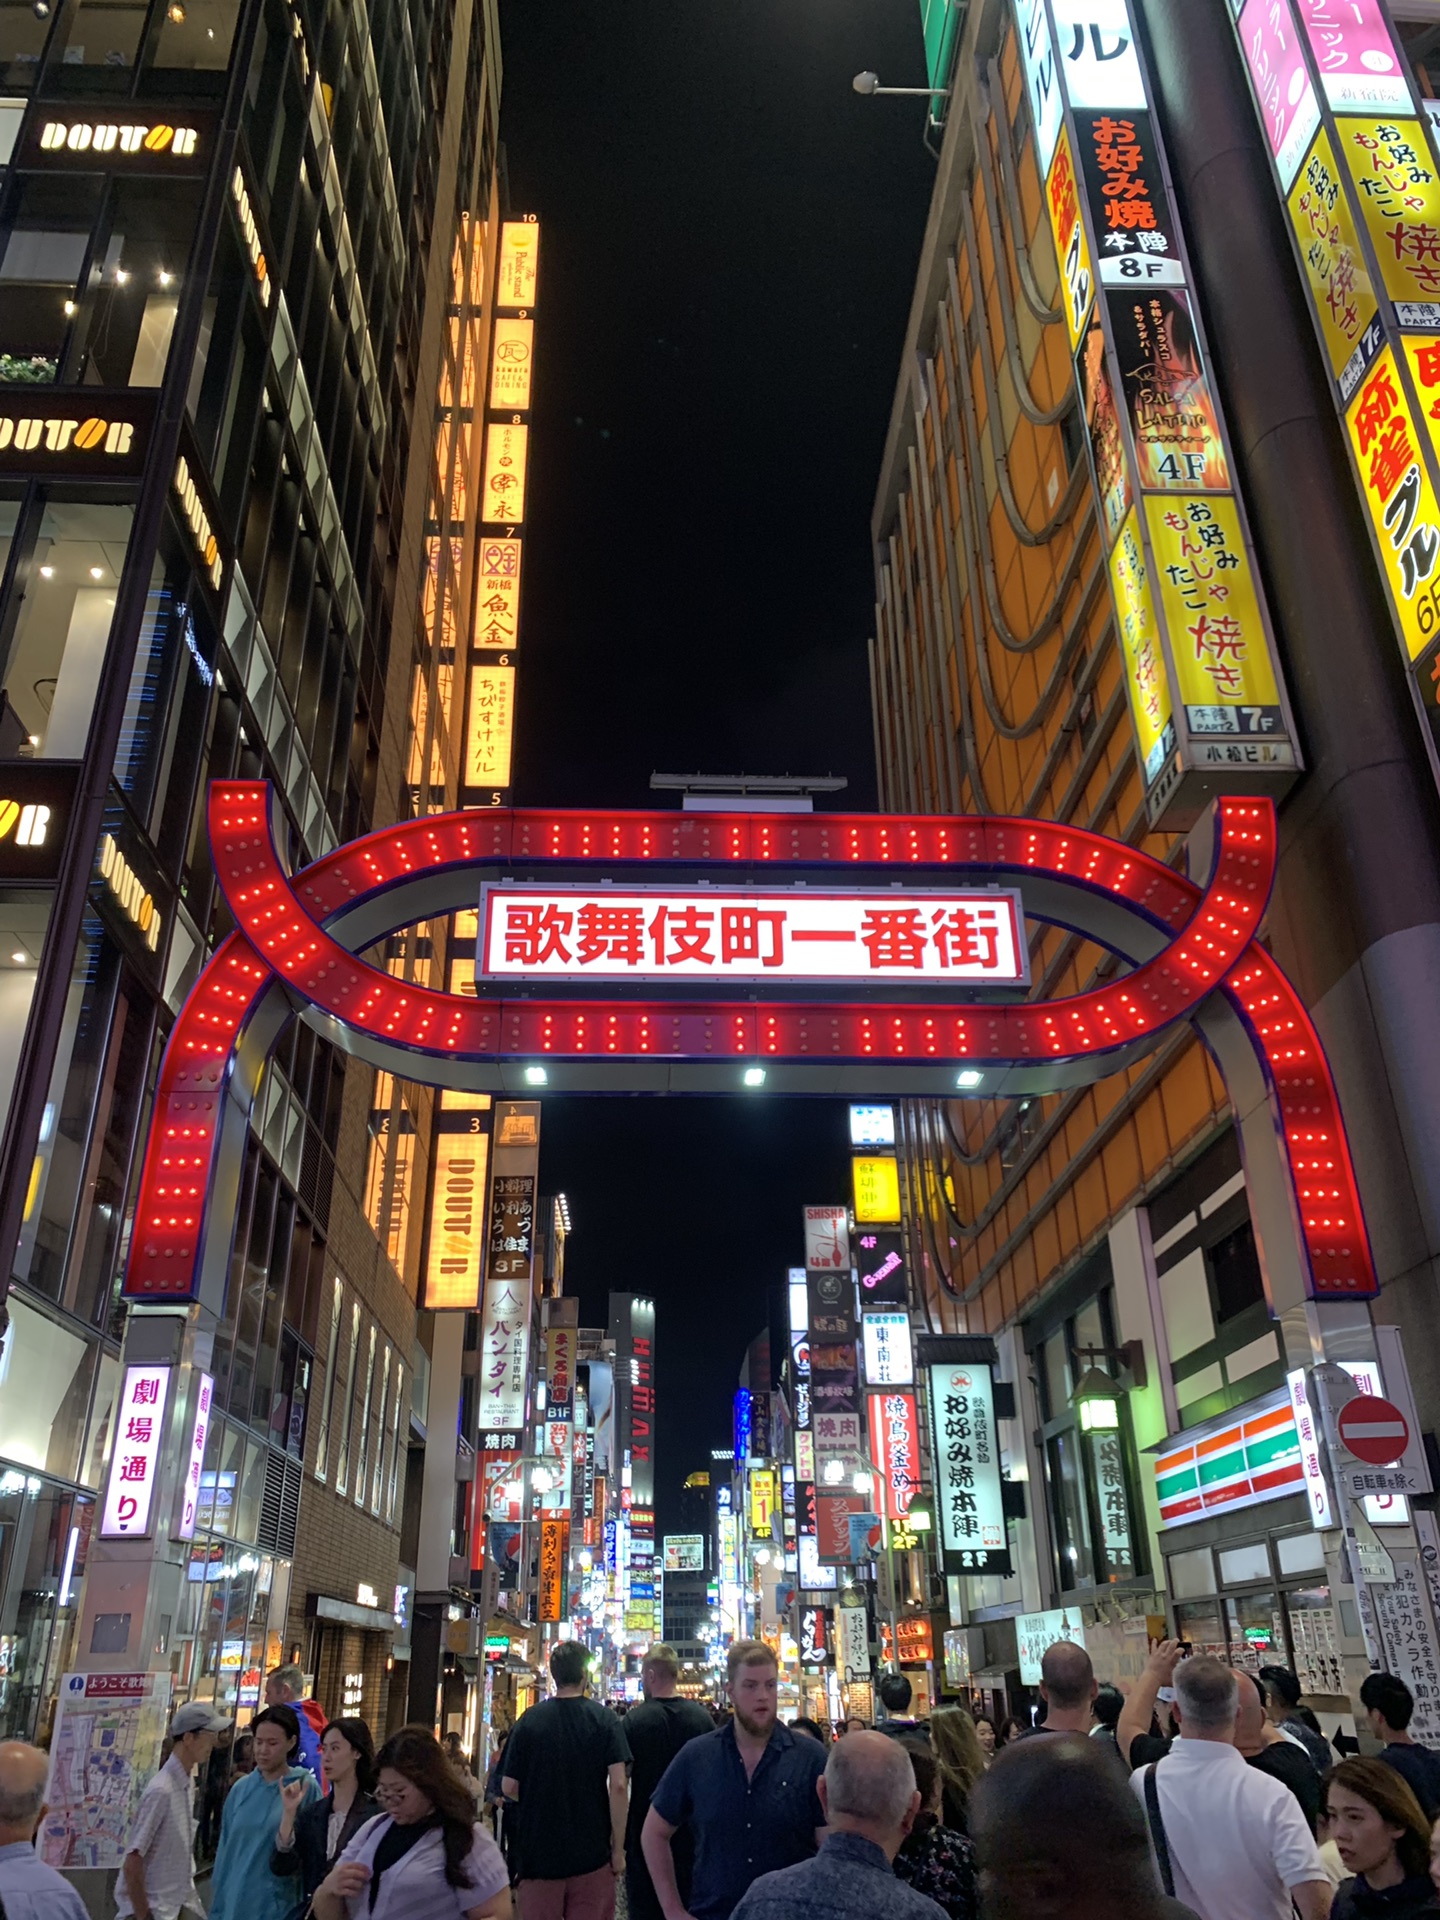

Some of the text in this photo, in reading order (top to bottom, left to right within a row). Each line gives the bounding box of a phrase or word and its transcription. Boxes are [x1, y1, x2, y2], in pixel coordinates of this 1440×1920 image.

[1068, 23, 1128, 62] ル
[41, 123, 197, 154] DOUTOR
[1376, 124, 1432, 184] お好み
[1092, 117, 1157, 229] お好み焼
[1354, 132, 1425, 211] もんじゃ
[1359, 177, 1403, 218] たこ
[522, 214, 537, 223] 10
[1104, 231, 1168, 252] 本陣
[1119, 258, 1163, 278] 8F
[518, 310, 527, 320] 9
[512, 415, 521, 424] 8
[1157, 453, 1206, 481] 4F
[493, 501, 516, 518] 永
[506, 527, 515, 538] 7
[1187, 502, 1240, 570] お好み
[1164, 512, 1229, 602] もんじゃ
[1165, 565, 1207, 610] たこ
[482, 593, 514, 644] 魚金
[499, 654, 509, 666] 6
[1188, 615, 1247, 697] 焼き
[475, 679, 497, 773] ちびすけバル
[1196, 721, 1235, 731] PART2
[1242, 707, 1274, 731] 7F
[1207, 746, 1277, 762] 小松ビル
[491, 793, 501, 805] 5
[505, 903, 998, 969] 歌舞伎町一番街
[470, 1118, 480, 1132] 3
[494, 1179, 533, 1193] 小料理
[440, 1159, 475, 1274] DOUTOR
[807, 1208, 845, 1219] SHISHA
[495, 1260, 524, 1273] 3F
[488, 1320, 511, 1398] バンタイ
[492, 1417, 509, 1426] 3F
[548, 1407, 570, 1418] B1F
[818, 1418, 857, 1438] 焼肉
[117, 1378, 160, 1521] 劇場通り
[485, 1434, 515, 1449] 焼肉
[1353, 1473, 1416, 1490] 自転車を除く
[549, 1510, 563, 1518] 4F
[756, 1529, 771, 1538] 4F
[893, 1535, 918, 1549] 2F
[962, 1551, 988, 1567] 2F
[1391, 1618, 1402, 1646] Safety
[1386, 1632, 1398, 1667] Camera
[1393, 1578, 1433, 1717] 防犯カメラ作動中
